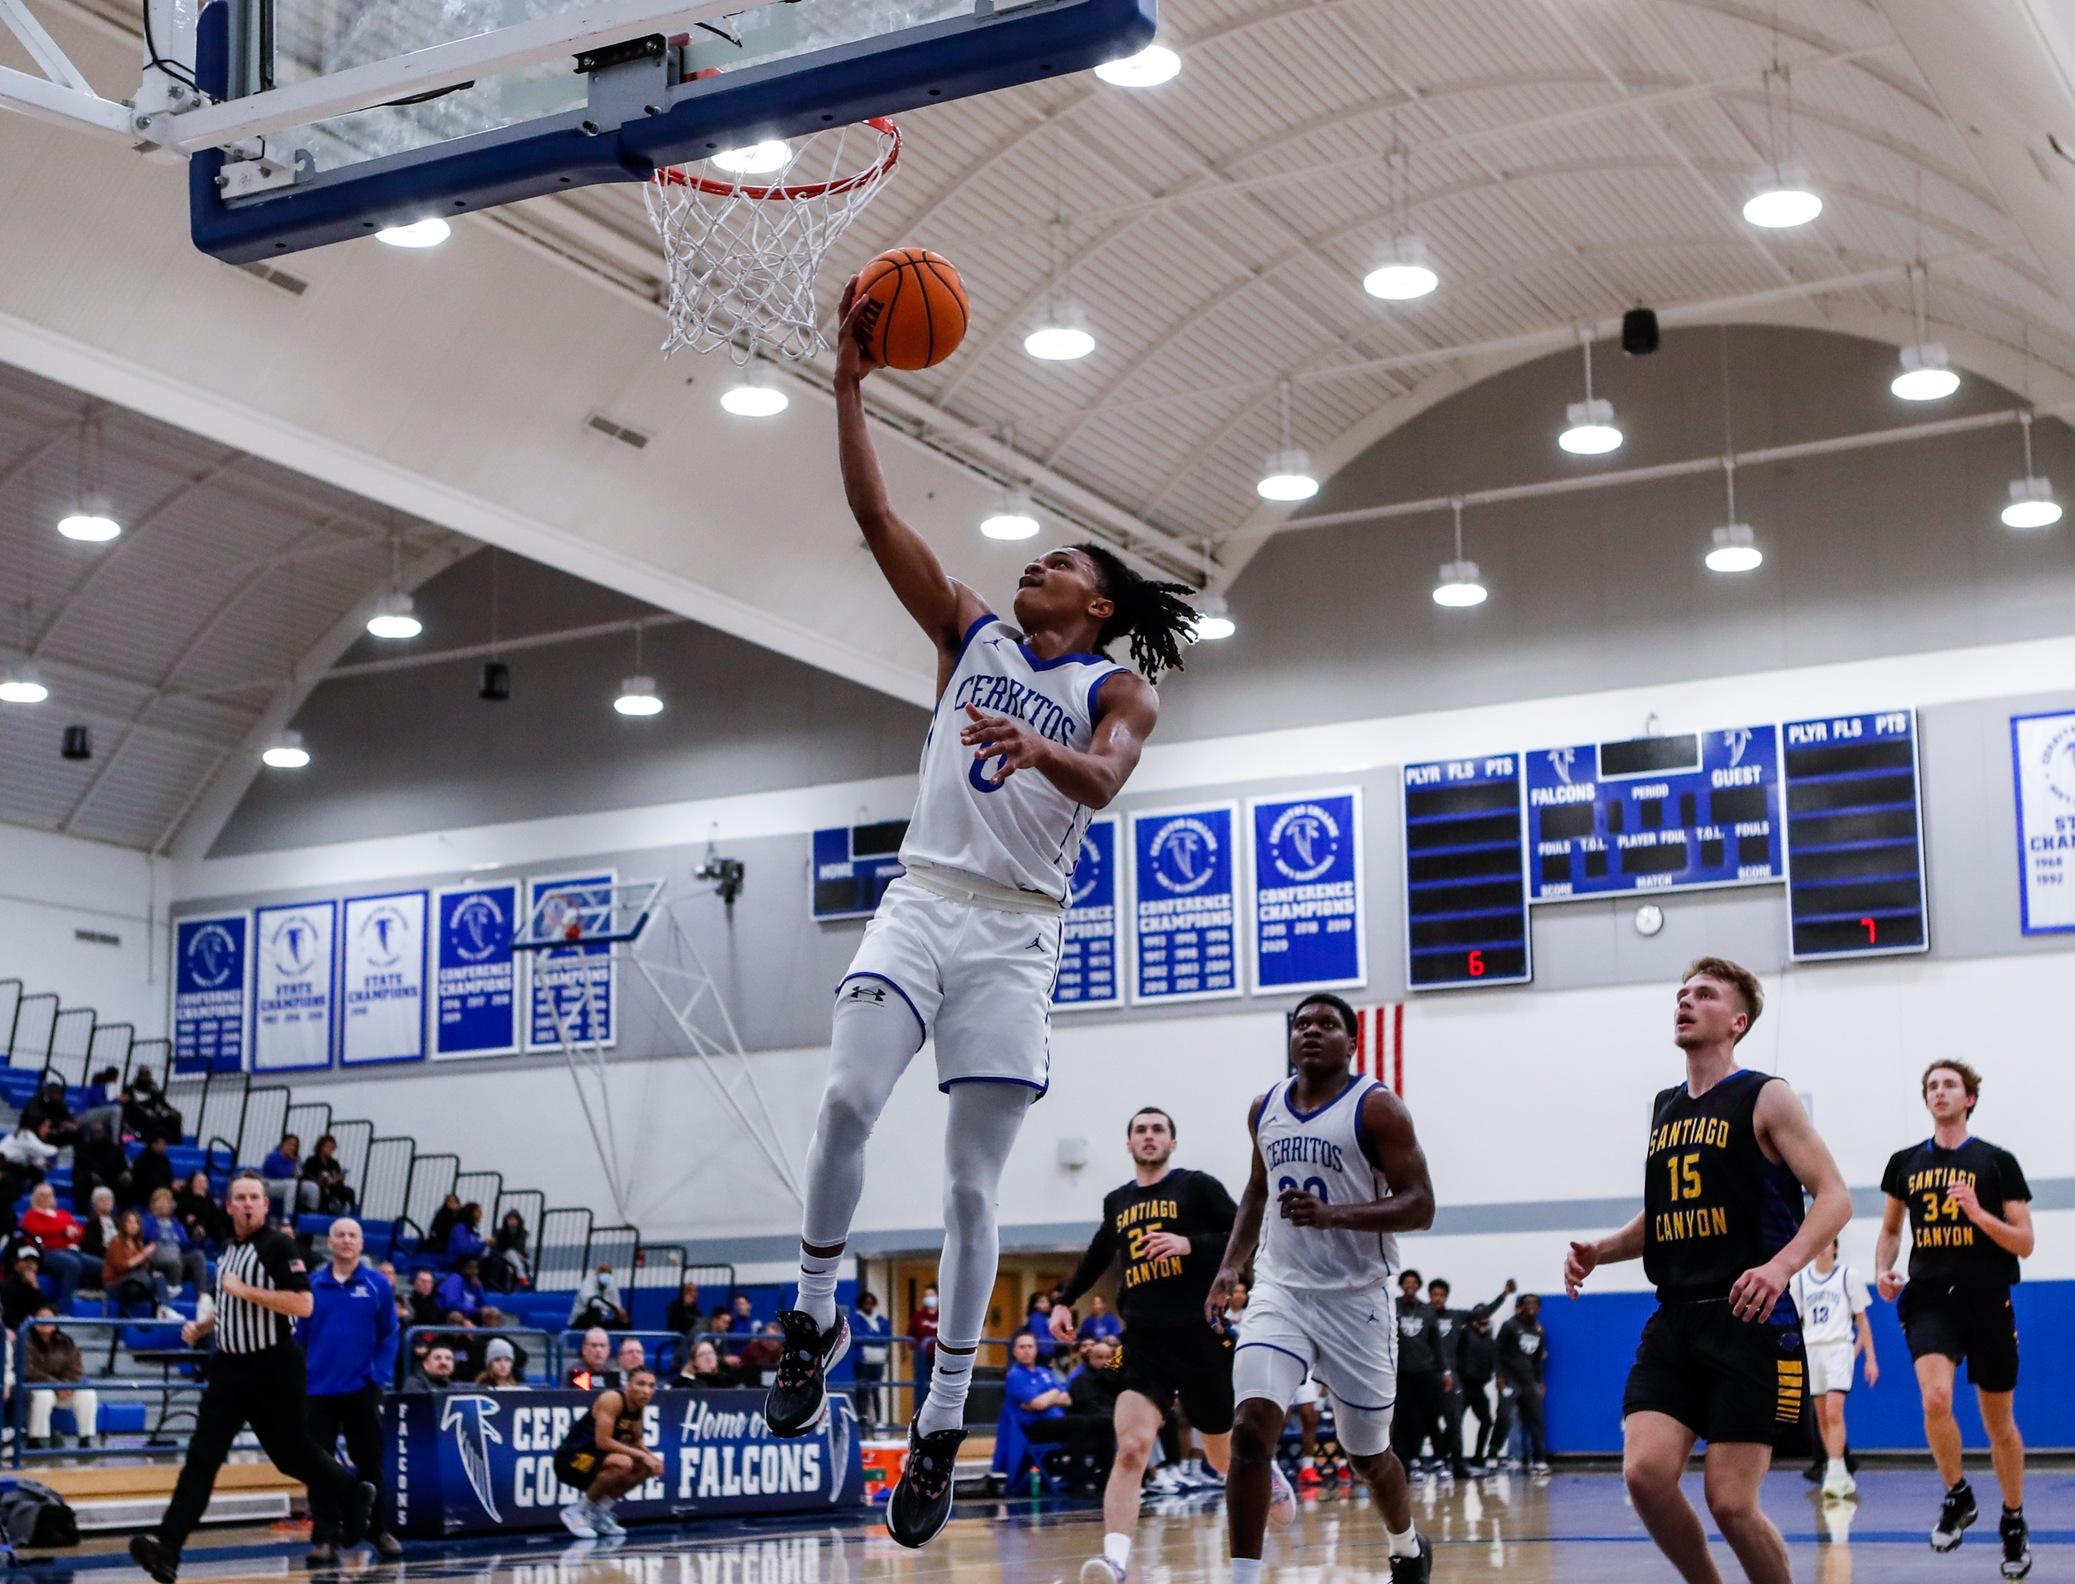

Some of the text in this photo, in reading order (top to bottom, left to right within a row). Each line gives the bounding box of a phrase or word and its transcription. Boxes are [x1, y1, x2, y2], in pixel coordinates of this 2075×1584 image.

[954, 674, 1076, 747] CERRITOS
[1787, 713, 1906, 744] PLYR FLS PTS
[1406, 758, 1513, 786] PLYR FLS PTS
[1711, 765, 1762, 788] GUEST
[1531, 783, 1596, 806] FALCONS
[1632, 784, 1669, 800] PERIOD
[1538, 840, 1571, 856] FOULS
[1618, 832, 1656, 849] PLAYER
[1661, 829, 1688, 844] FOUL
[1735, 821, 1770, 837] FOULS
[1636, 874, 1672, 888] MATCH
[1737, 865, 1772, 879] SCORE
[1259, 880, 1354, 905] CONFERENCE
[1540, 883, 1573, 897] SCORE
[1064, 904, 1114, 922] ERENCE
[1138, 893, 1231, 916] CONFERENCE
[1259, 897, 1356, 922] CHAMPIONS
[1064, 920, 1115, 940] PIONS
[1139, 909, 1233, 934] CHAMPIONS
[1860, 917, 1876, 944] 7
[440, 962, 512, 982] CONFERENCE
[1468, 950, 1485, 976] 6
[364, 973, 403, 988] STATE
[440, 976, 513, 998] CHAMPIONS
[262, 995, 325, 1012] CHAMPIONS
[348, 986, 418, 1003] CHAMPIONS
[1649, 1116, 1730, 1157] SANTIAGO
[1667, 1153, 1702, 1201] 15
[1908, 1168, 1976, 1196] SANTIAGO
[1116, 1200, 1178, 1233] SANTIAGO
[1922, 1192, 1960, 1222] 34
[1655, 1207, 1728, 1243] CANYON
[1916, 1226, 1973, 1248] CANYON
[1125, 1256, 1183, 1289] CANYON
[513, 1405, 660, 1451] CERS
[680, 1400, 746, 1443] Home
[397, 1403, 408, 1526] FALCONS
[678, 1443, 821, 1498] FALCONS
